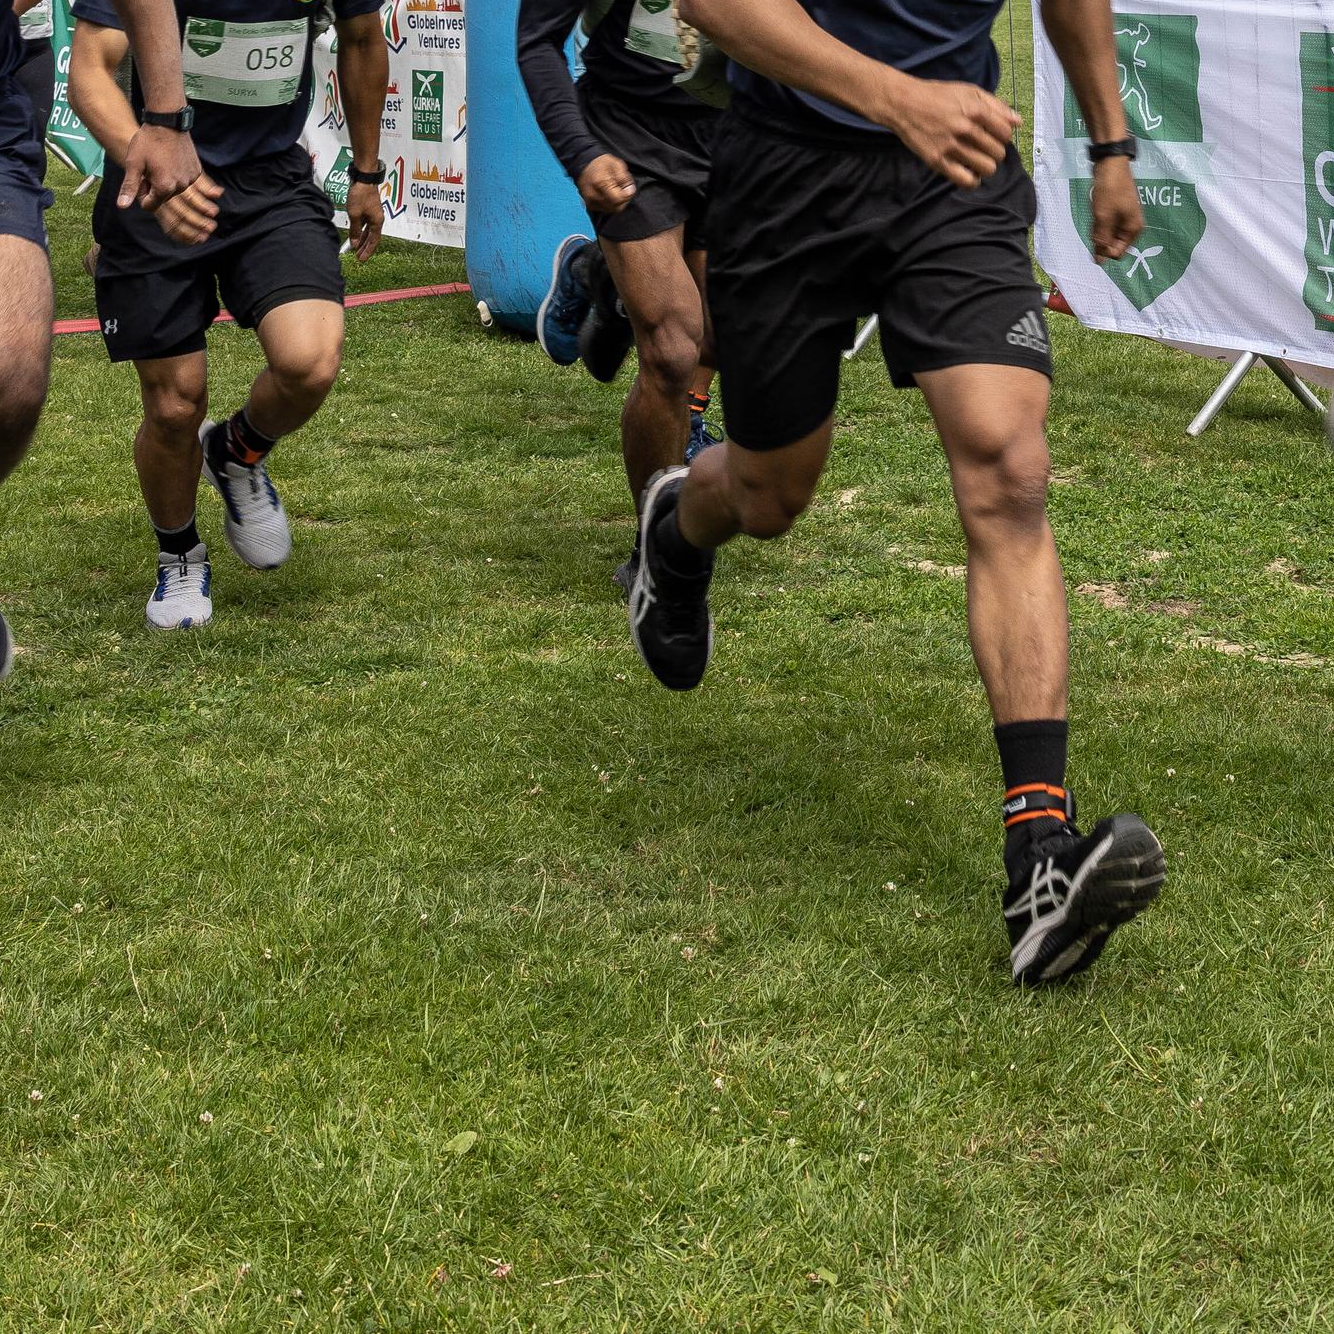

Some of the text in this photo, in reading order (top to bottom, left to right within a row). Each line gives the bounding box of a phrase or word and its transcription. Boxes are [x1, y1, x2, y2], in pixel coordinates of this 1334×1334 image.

[417, 32, 461, 50] Ventures
[246, 44, 294, 71] 058
[226, 87, 258, 97] SURYA
[413, 96, 441, 112] GURKHA
[414, 122, 441, 135] TRUST
[410, 182, 466, 204] GlobeInvest
[417, 202, 456, 221] Ventures
